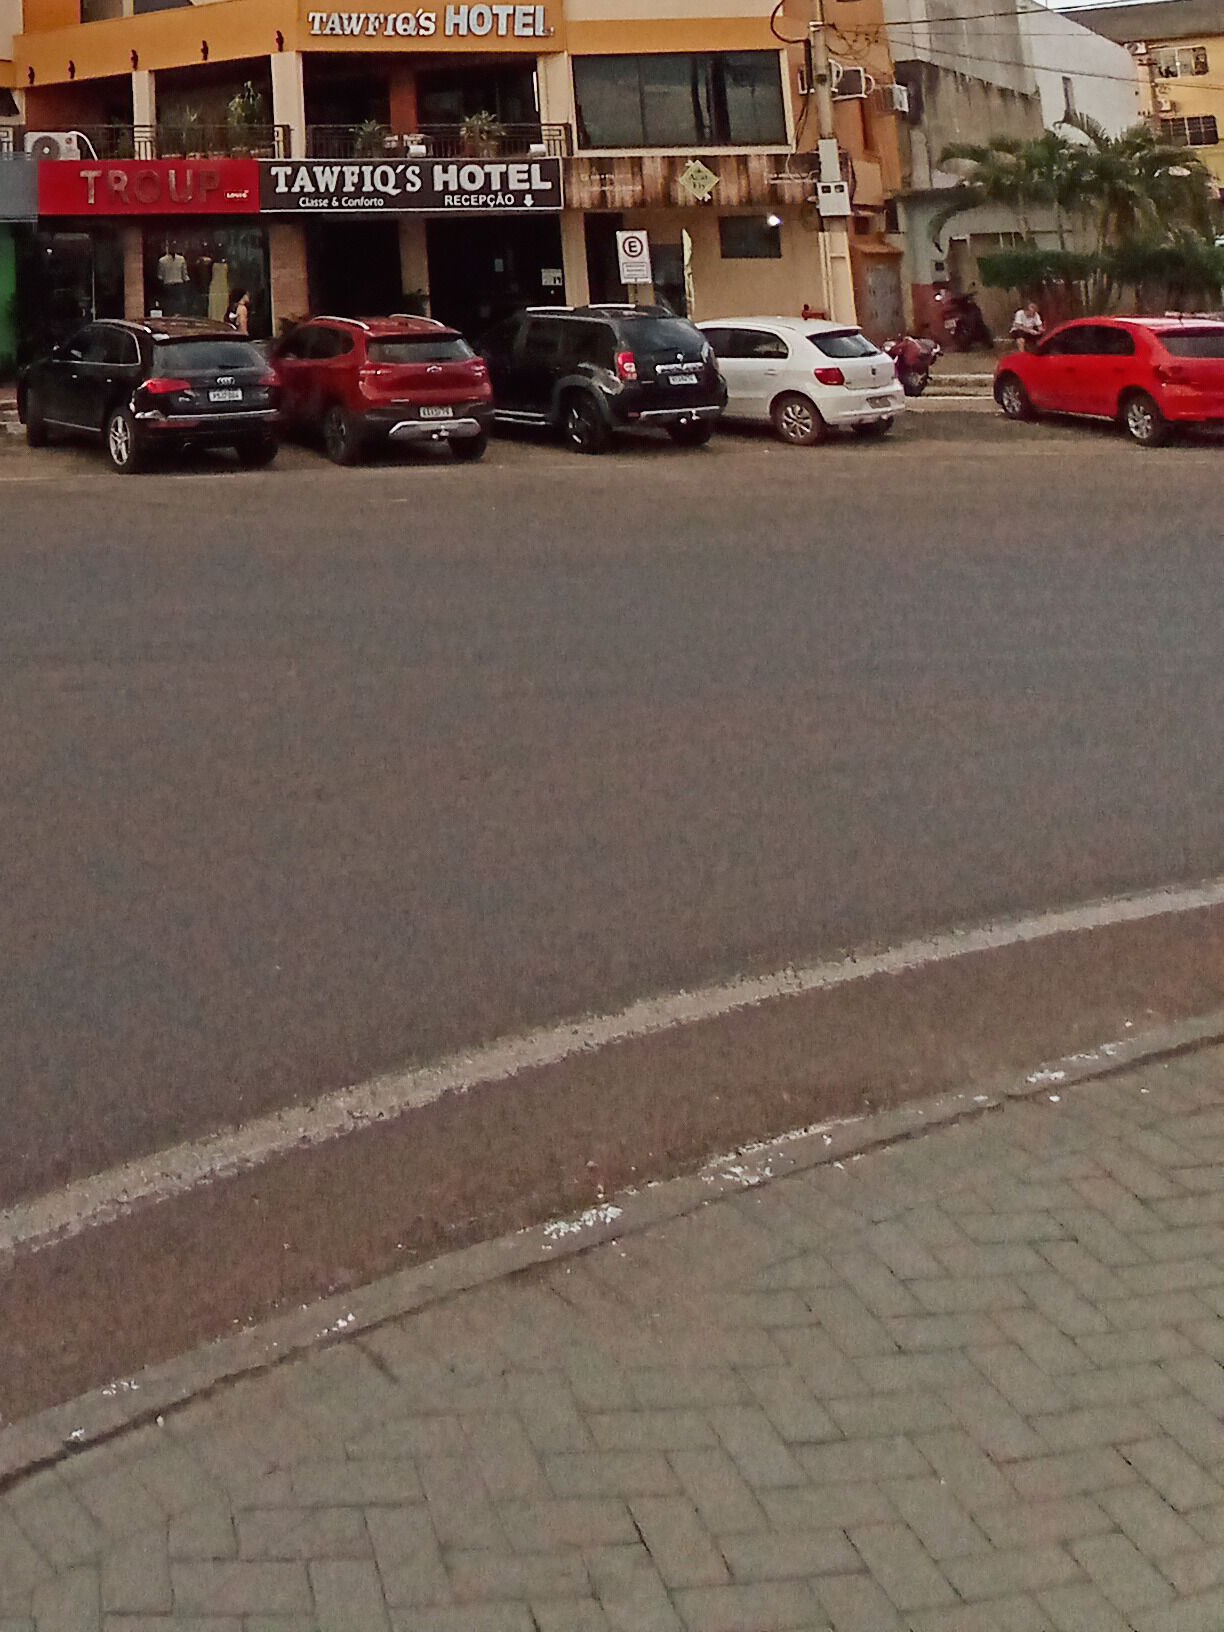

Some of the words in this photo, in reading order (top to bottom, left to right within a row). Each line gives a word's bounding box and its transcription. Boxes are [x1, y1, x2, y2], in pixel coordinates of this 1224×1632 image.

[445, 4, 553, 37] HOTEL
[80, 169, 221, 204] TROUP
[433, 164, 553, 191] HOTEL
[299, 196, 328, 207] Classe
[331, 197, 339, 207] &
[341, 196, 385, 207] Conforto
[444, 191, 515, 207] RECEPÇÃO
[628, 240, 638, 253] E
